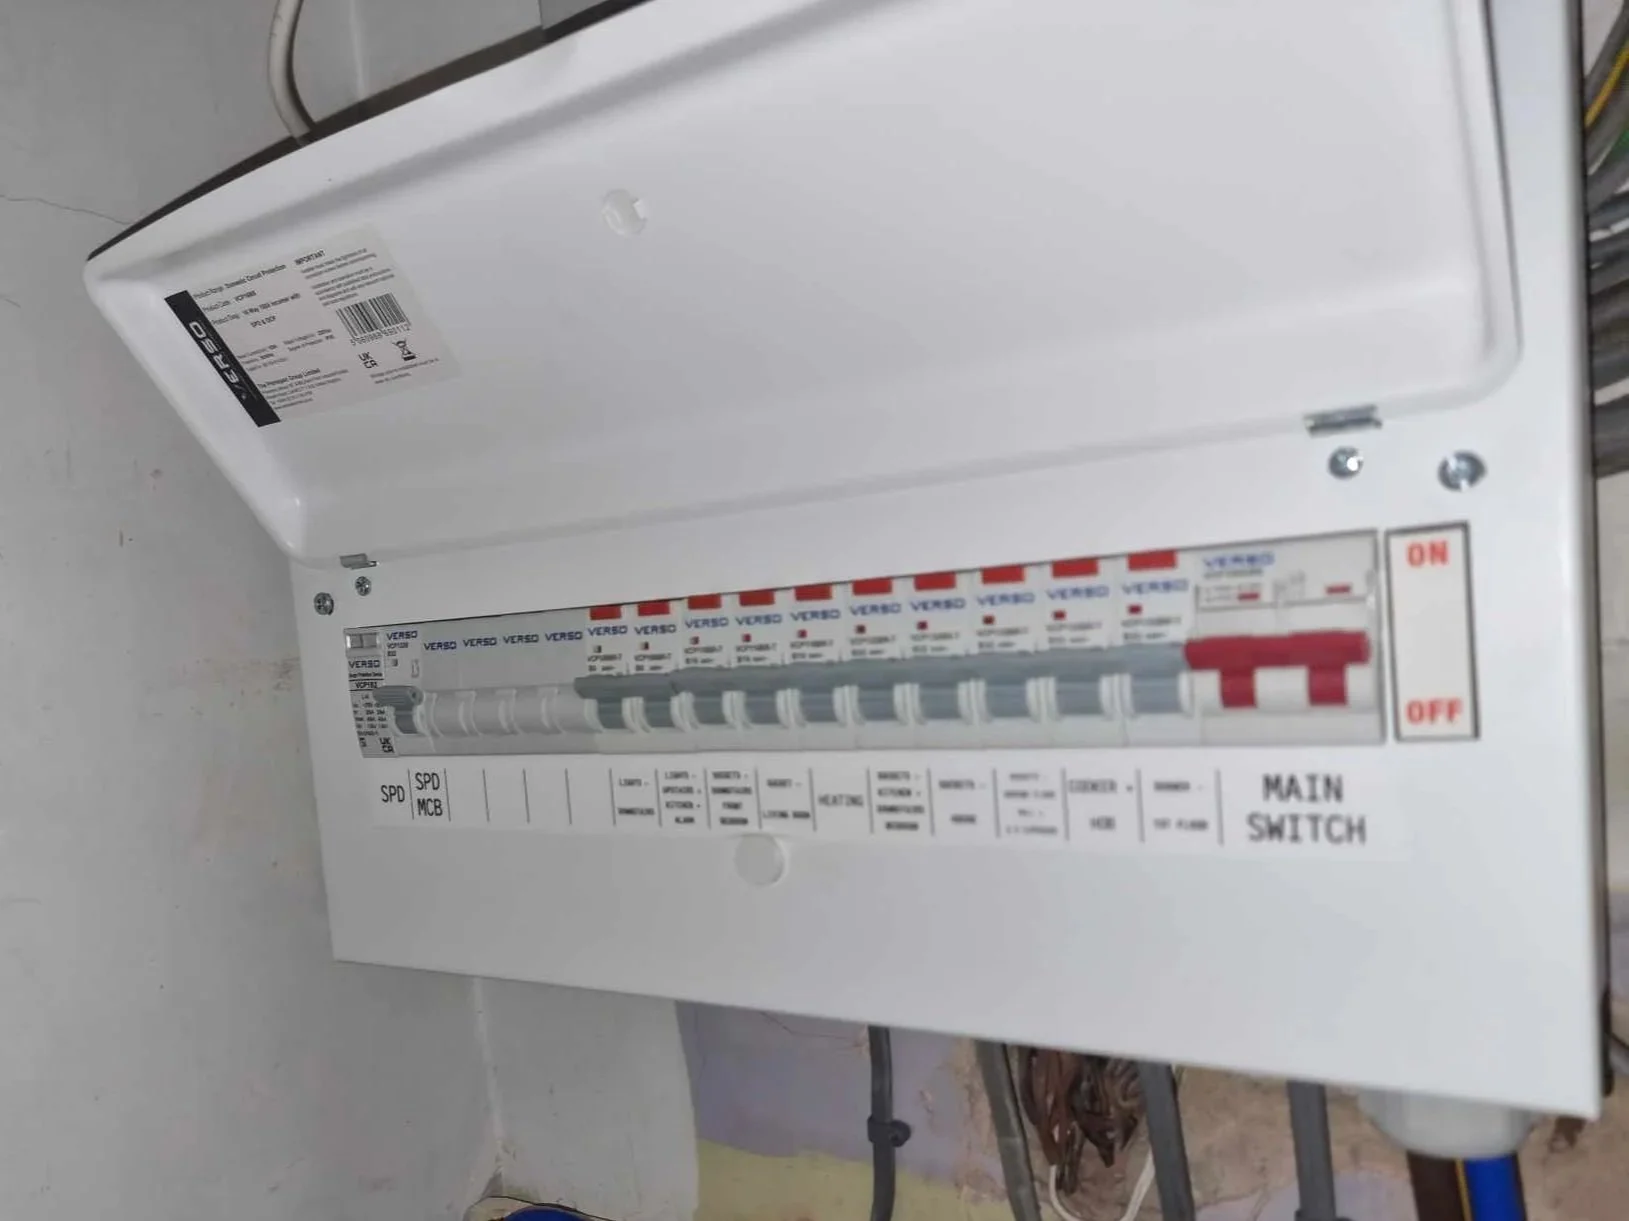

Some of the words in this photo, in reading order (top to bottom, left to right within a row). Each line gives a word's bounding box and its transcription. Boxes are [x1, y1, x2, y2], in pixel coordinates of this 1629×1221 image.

[294, 249, 325, 266] IMPORTANT
[358, 350, 373, 361] UK
[1203, 550, 1275, 568] VERSO
[1406, 540, 1449, 567] ON
[1046, 585, 1110, 600] VERSO
[1121, 578, 1189, 595] VERSO
[911, 597, 966, 612] VERSO
[977, 592, 1035, 606] VERSO
[790, 609, 841, 621] VERSO
[850, 603, 902, 616] VERSO
[684, 617, 729, 629] VERSO
[735, 614, 782, 626] VERSO
[386, 630, 418, 641] VERSO
[545, 631, 583, 642] VERSO
[588, 625, 628, 636] VERSO
[634, 624, 677, 635] VERSO
[424, 641, 457, 651] VERSO
[463, 637, 497, 648] VERSO
[503, 634, 539, 644] VERSO
[348, 659, 380, 669] VERSO
[1406, 698, 1463, 725] OFF
[415, 772, 441, 791] SPD
[1261, 773, 1344, 802] MAIN
[381, 784, 406, 804] SPD
[818, 793, 864, 808] HEATING
[417, 797, 443, 817] MCB
[1246, 812, 1367, 844] SWITCH
